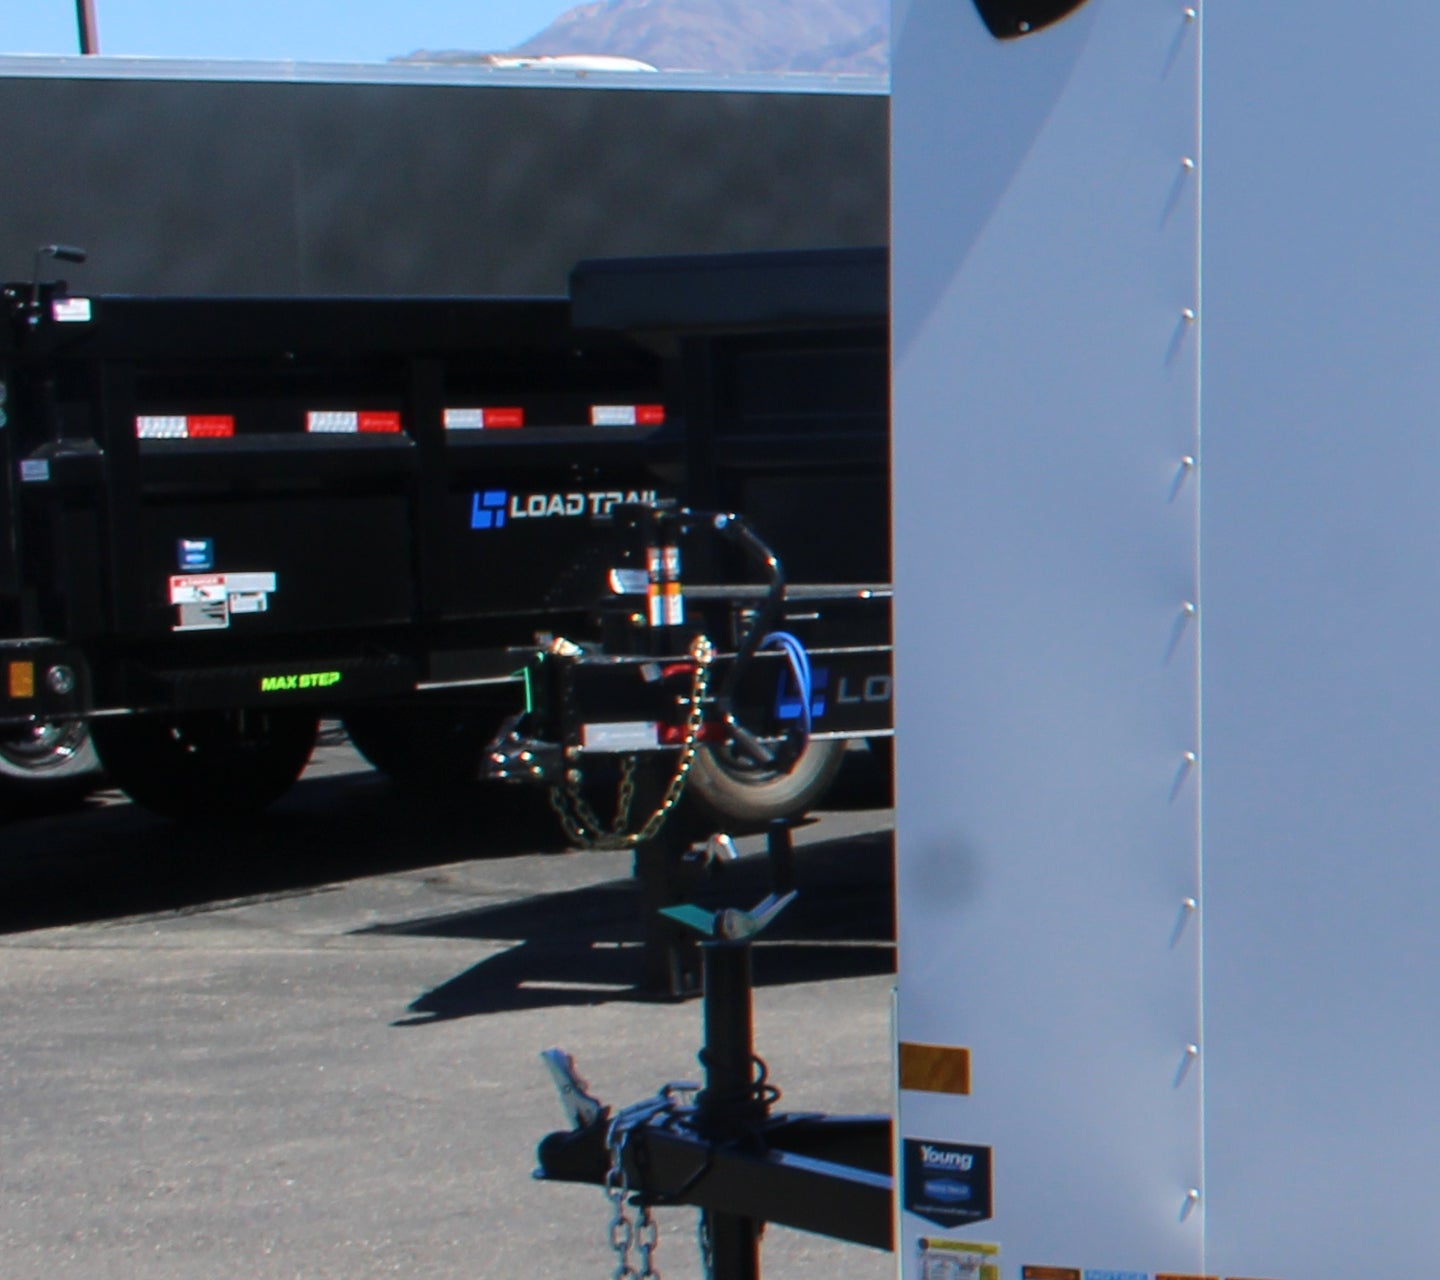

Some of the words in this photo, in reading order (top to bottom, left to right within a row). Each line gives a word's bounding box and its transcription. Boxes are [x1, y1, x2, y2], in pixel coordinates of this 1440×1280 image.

[510, 493, 585, 518] LOAD
[262, 675, 297, 691] MAX
[299, 672, 341, 688] STEP
[921, 1145, 974, 1171] Young
